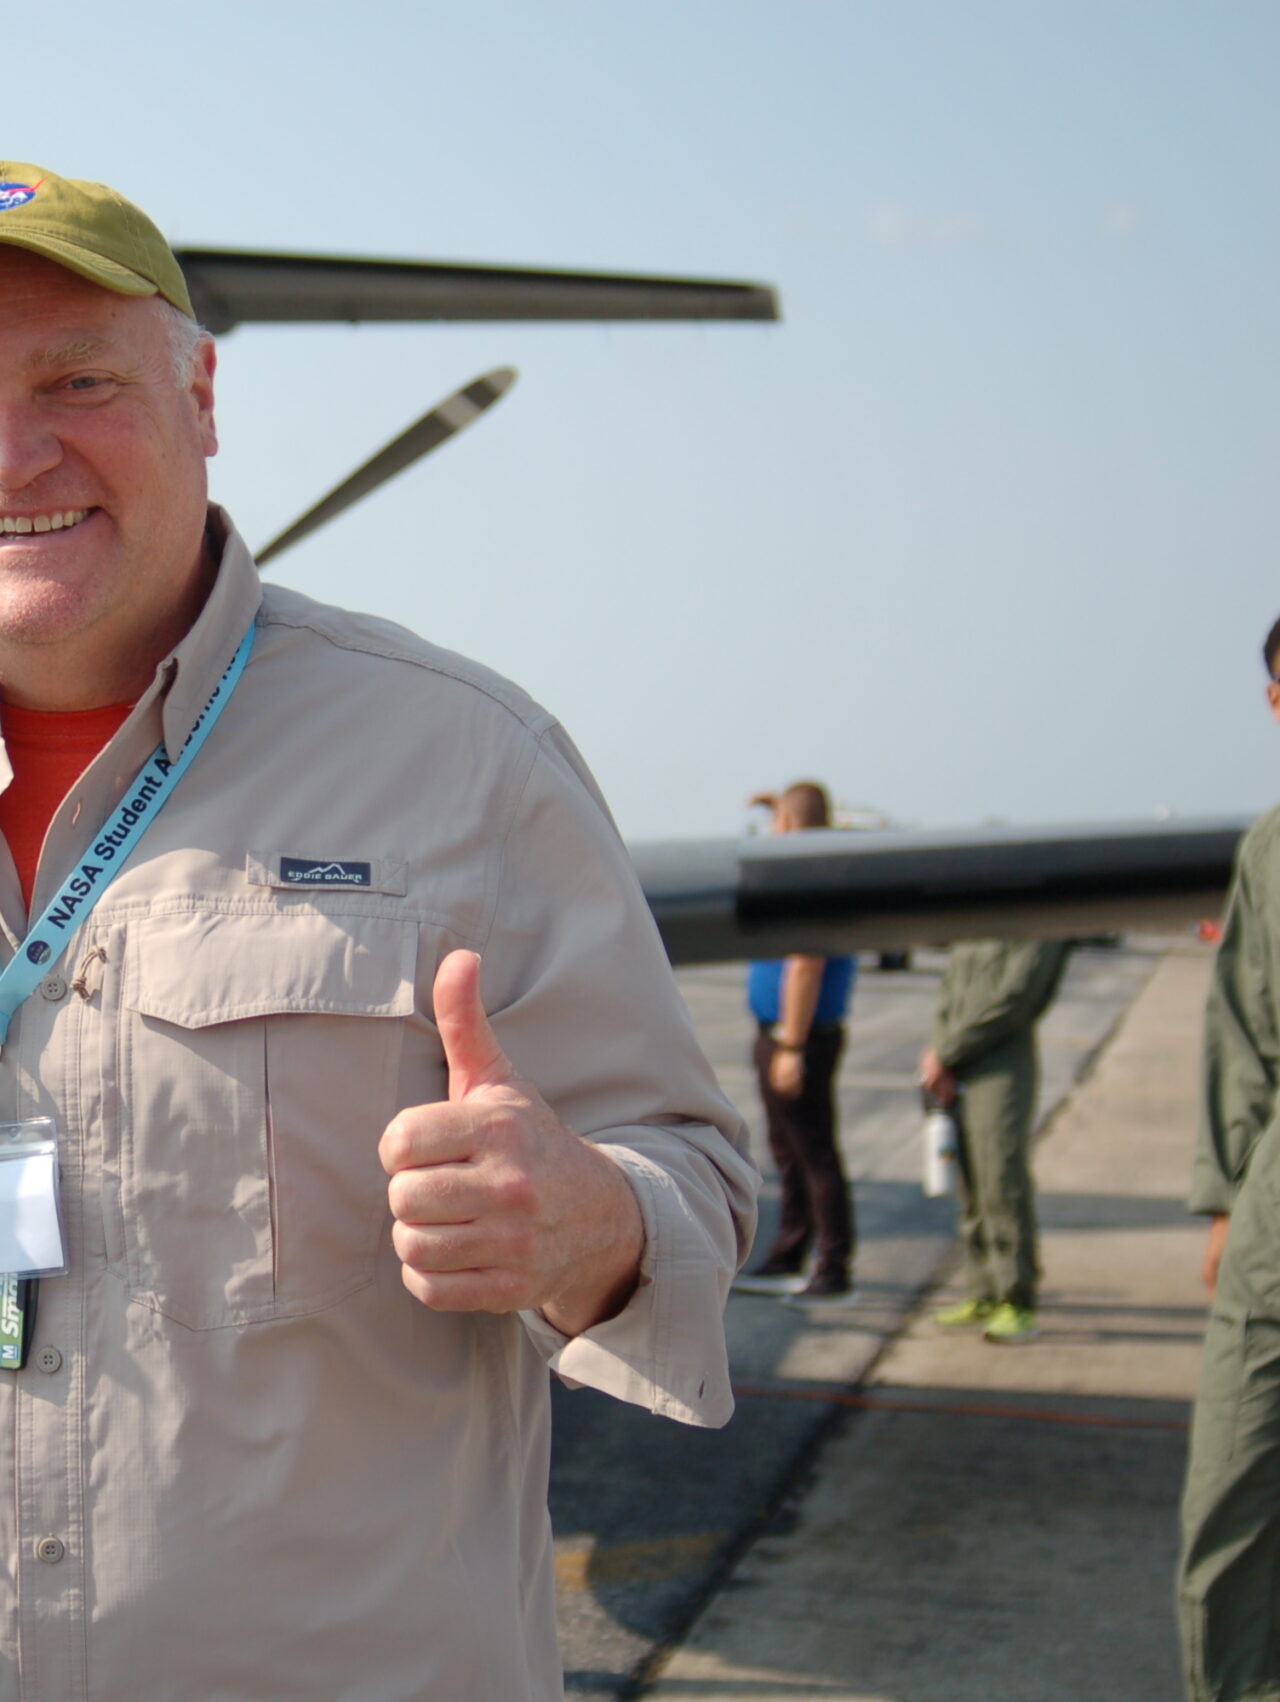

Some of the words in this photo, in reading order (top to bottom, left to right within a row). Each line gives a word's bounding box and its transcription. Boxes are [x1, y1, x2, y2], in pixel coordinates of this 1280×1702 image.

[47, 863, 104, 930] NASA
[94, 775, 162, 861] Student
[288, 871, 322, 880] EDDIE
[325, 874, 362, 882] BAUER
